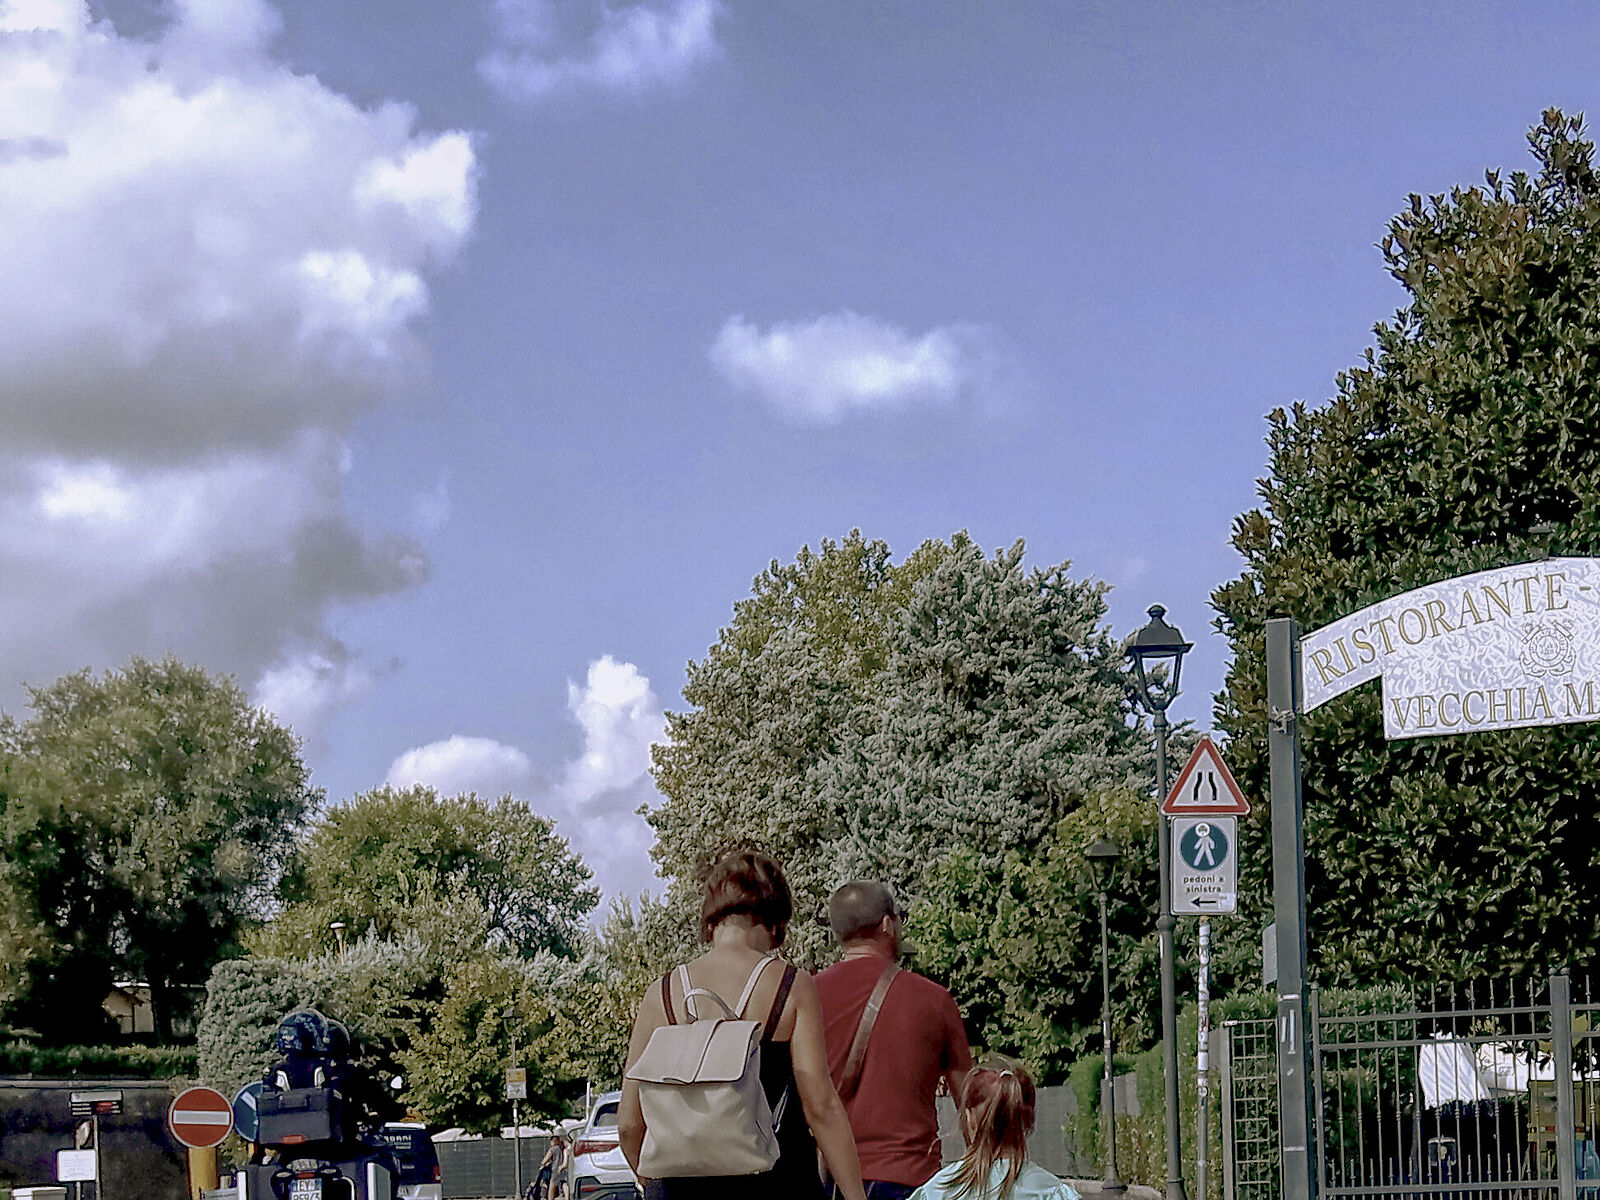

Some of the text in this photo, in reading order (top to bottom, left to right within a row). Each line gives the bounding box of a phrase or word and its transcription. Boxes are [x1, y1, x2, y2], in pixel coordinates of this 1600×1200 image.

[1309, 572, 1569, 687] RISTORANTE
[1390, 685, 1554, 731] VECCHIA
[1183, 874, 1215, 885] pedoni
[1186, 884, 1222, 893] sinistra
